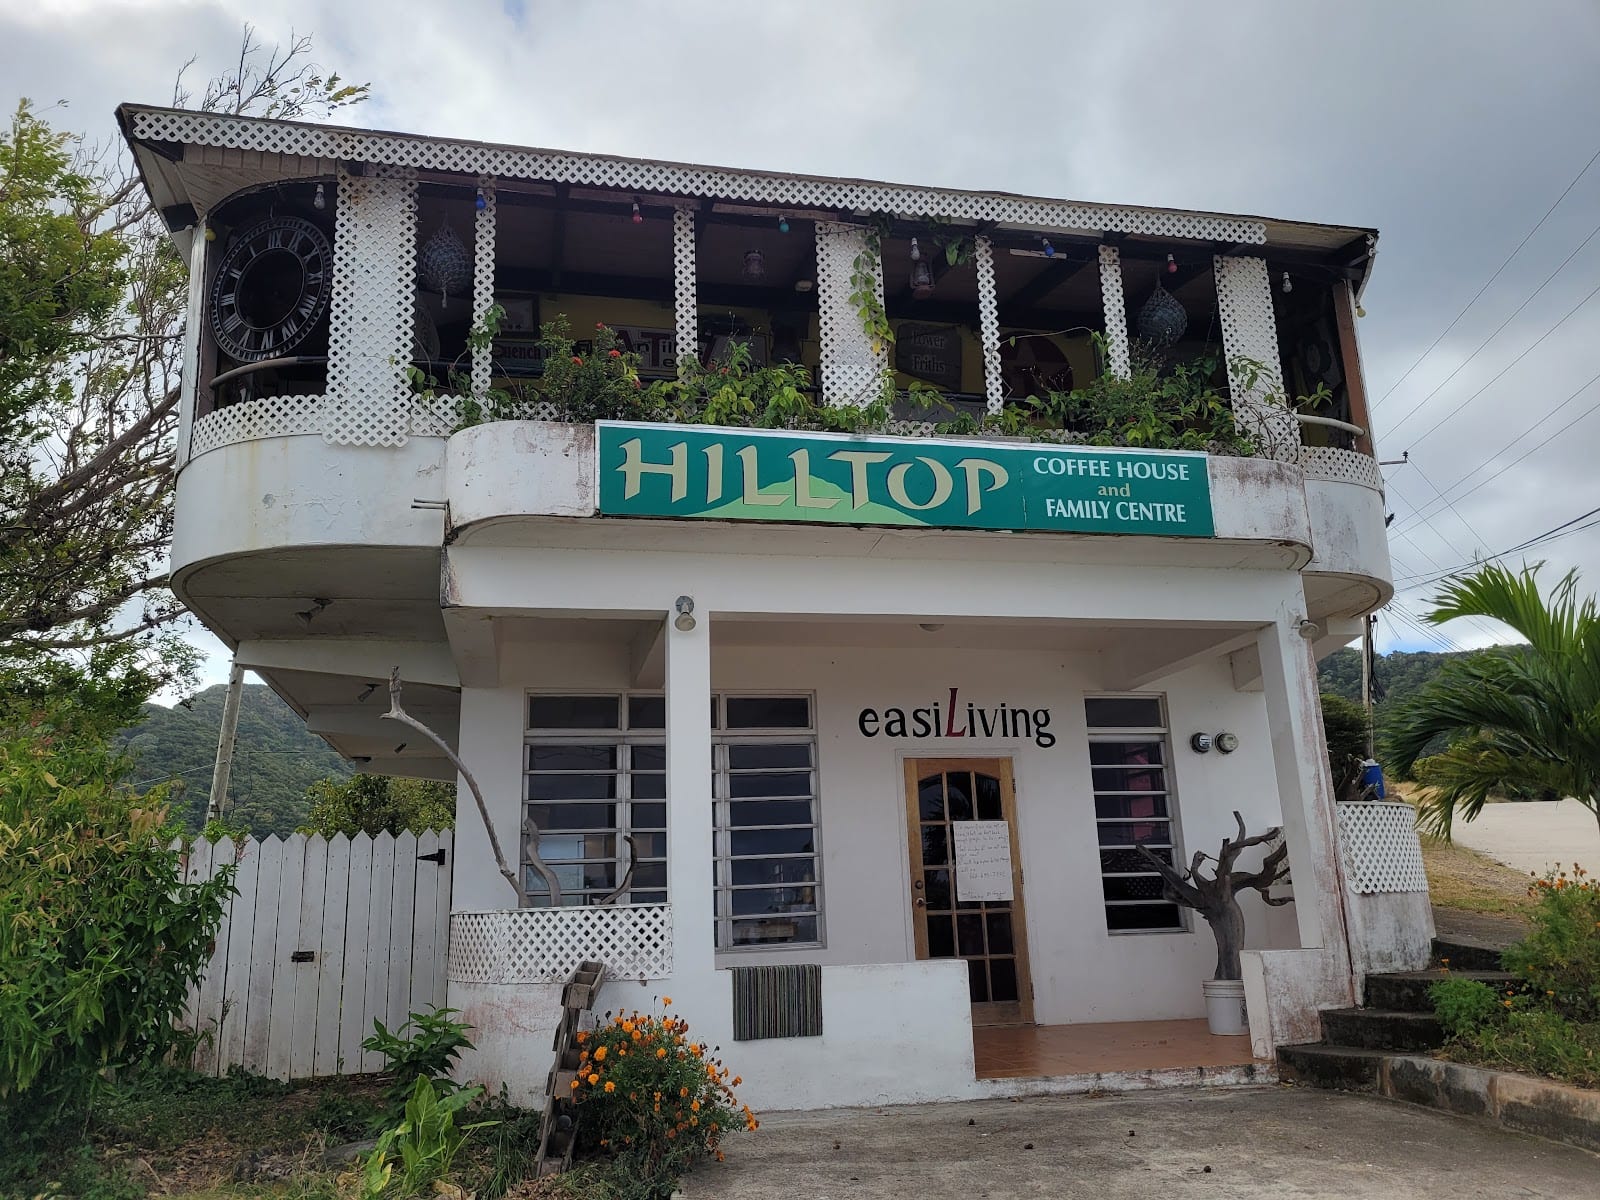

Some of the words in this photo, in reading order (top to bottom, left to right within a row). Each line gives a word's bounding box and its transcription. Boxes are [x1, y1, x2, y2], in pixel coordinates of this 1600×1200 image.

[615, 437, 1010, 517] HILLTOP
[1033, 457, 1111, 477] COFFEE
[1117, 461, 1190, 481] HOUSE
[1098, 483, 1131, 497] and
[1046, 498, 1111, 519] FAMILY
[1115, 501, 1187, 523] CENTRE
[858, 687, 1056, 748] easiLiving
